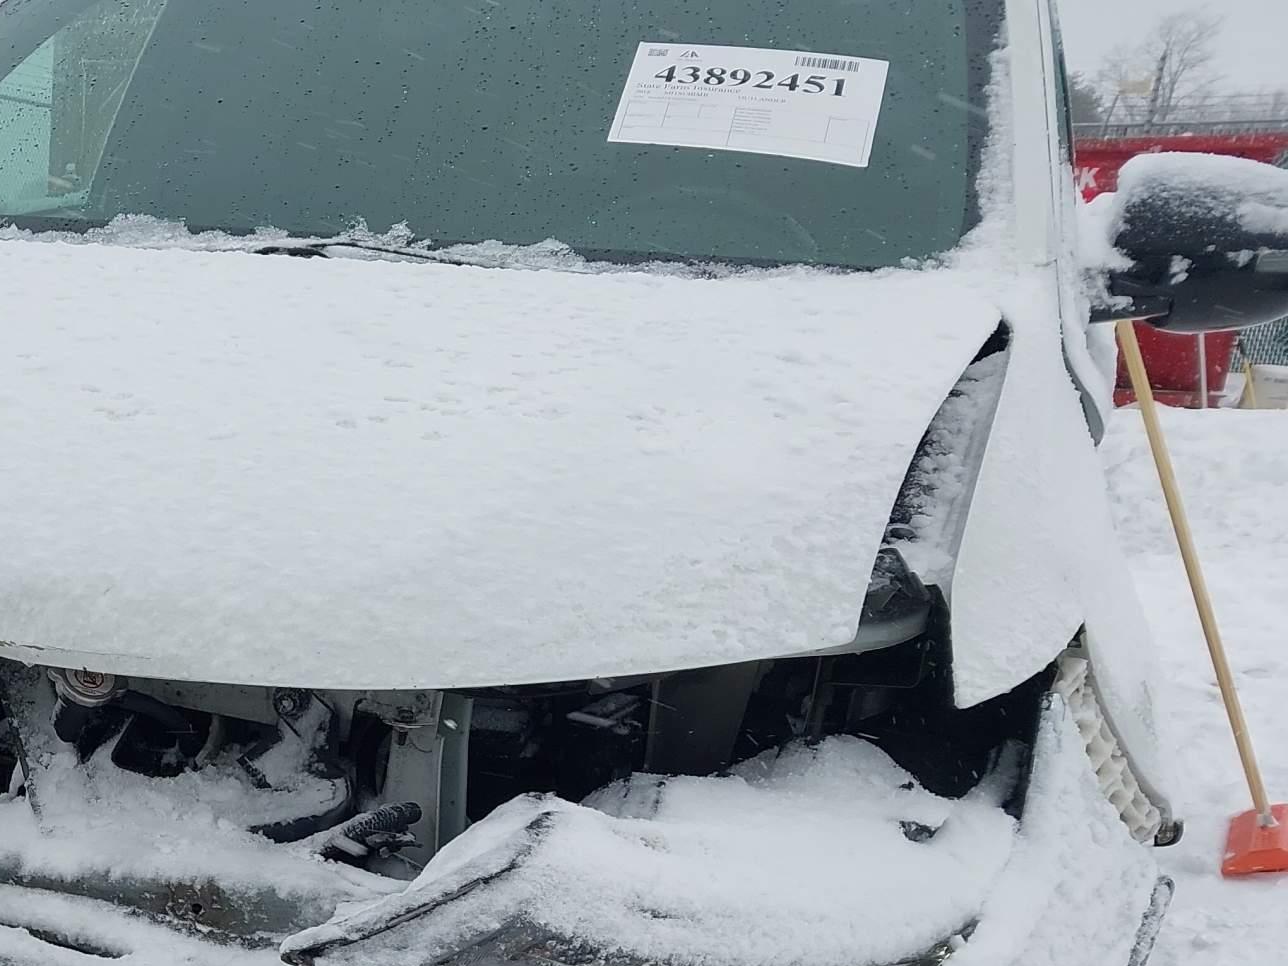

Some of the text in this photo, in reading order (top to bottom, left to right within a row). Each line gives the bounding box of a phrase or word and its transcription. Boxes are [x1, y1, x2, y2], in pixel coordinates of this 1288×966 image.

[654, 65, 846, 97] 43892451
[664, 83, 692, 91] Farm
[693, 84, 742, 94] Insurance
